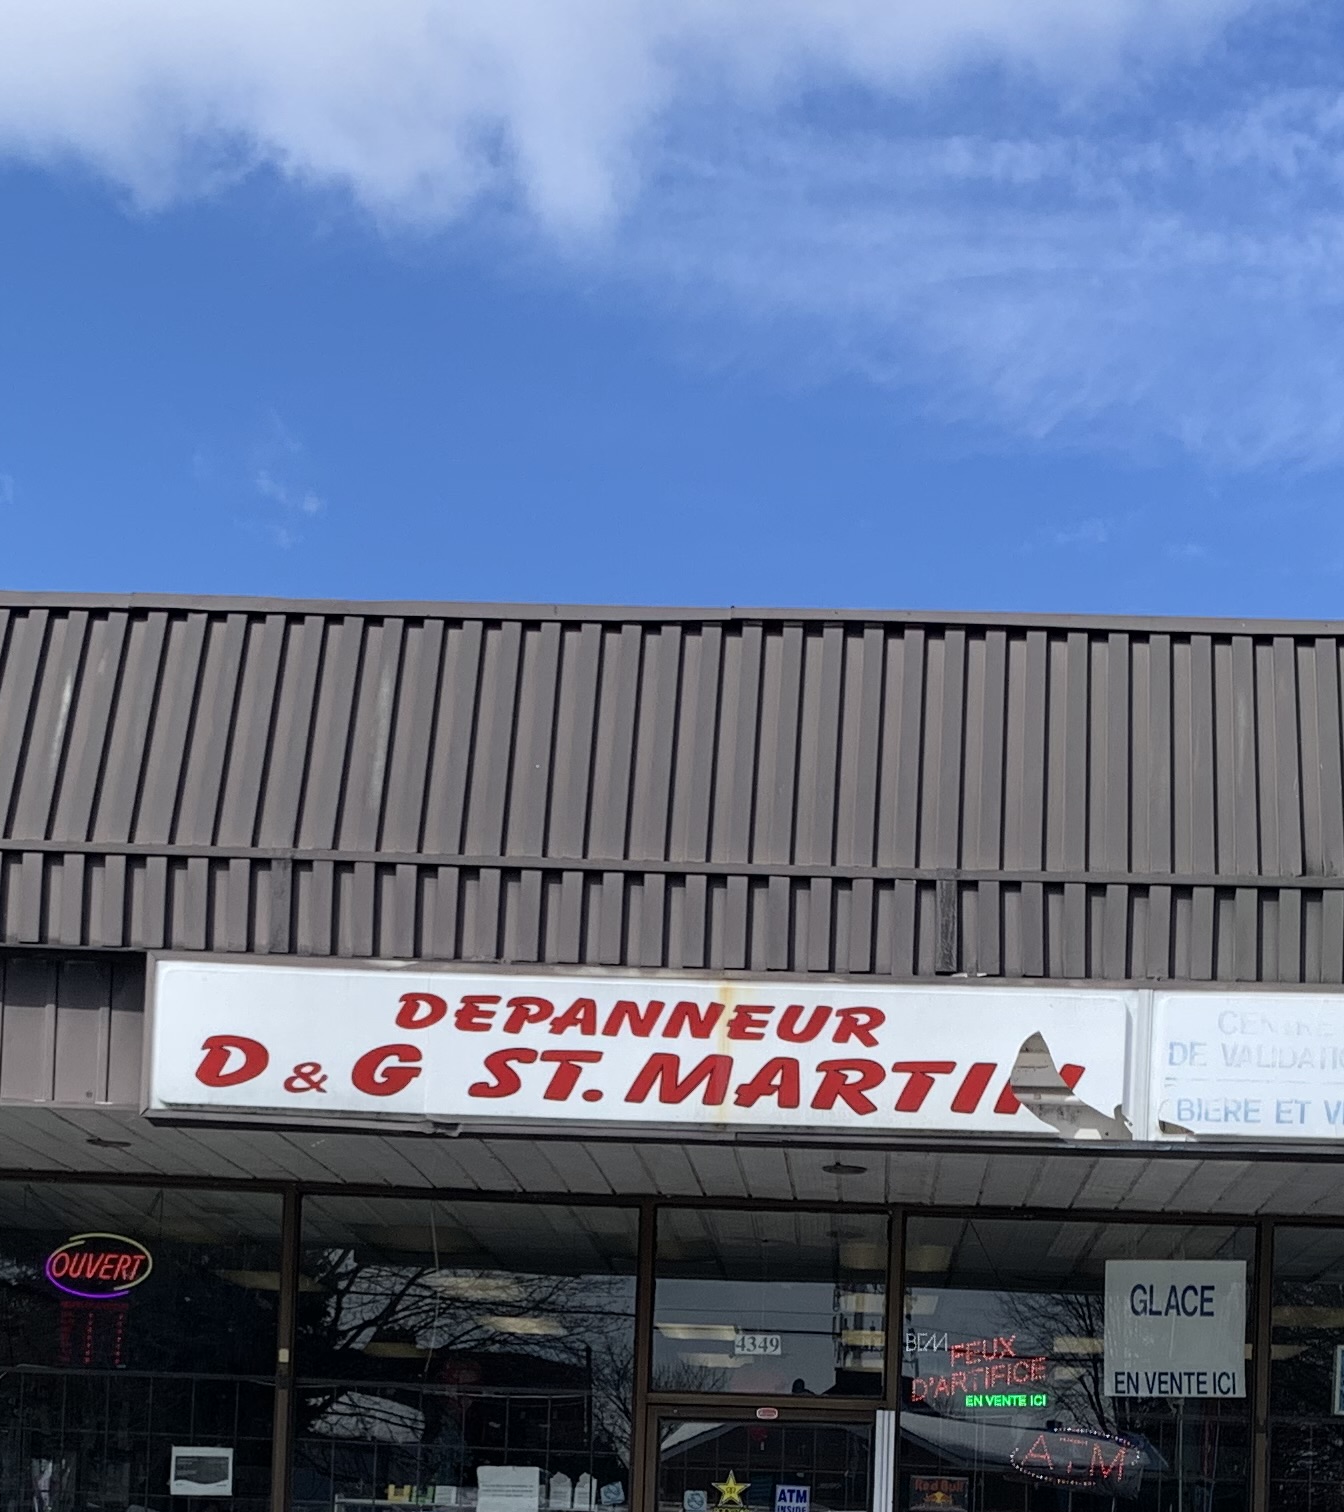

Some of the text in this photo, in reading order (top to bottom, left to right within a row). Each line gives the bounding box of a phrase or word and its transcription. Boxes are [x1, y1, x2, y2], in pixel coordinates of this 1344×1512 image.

[394, 991, 886, 1048] DEPANNEUR
[1168, 1042, 1207, 1067] DE
[194, 1035, 270, 1088] D
[283, 1061, 328, 1094] &
[351, 1043, 423, 1096] G
[468, 1047, 604, 1102] ST.
[1275, 1099, 1312, 1125] ET
[52, 1252, 146, 1280] OUVERT
[1130, 1283, 1215, 1317] GLACE
[736, 1335, 780, 1353] 4349
[1115, 1372, 1236, 1396] EN VENTE ICI
[965, 1394, 1047, 1407] EN VENTE ICI
[778, 1489, 807, 1503] ATM
[914, 1479, 938, 1491] Red
